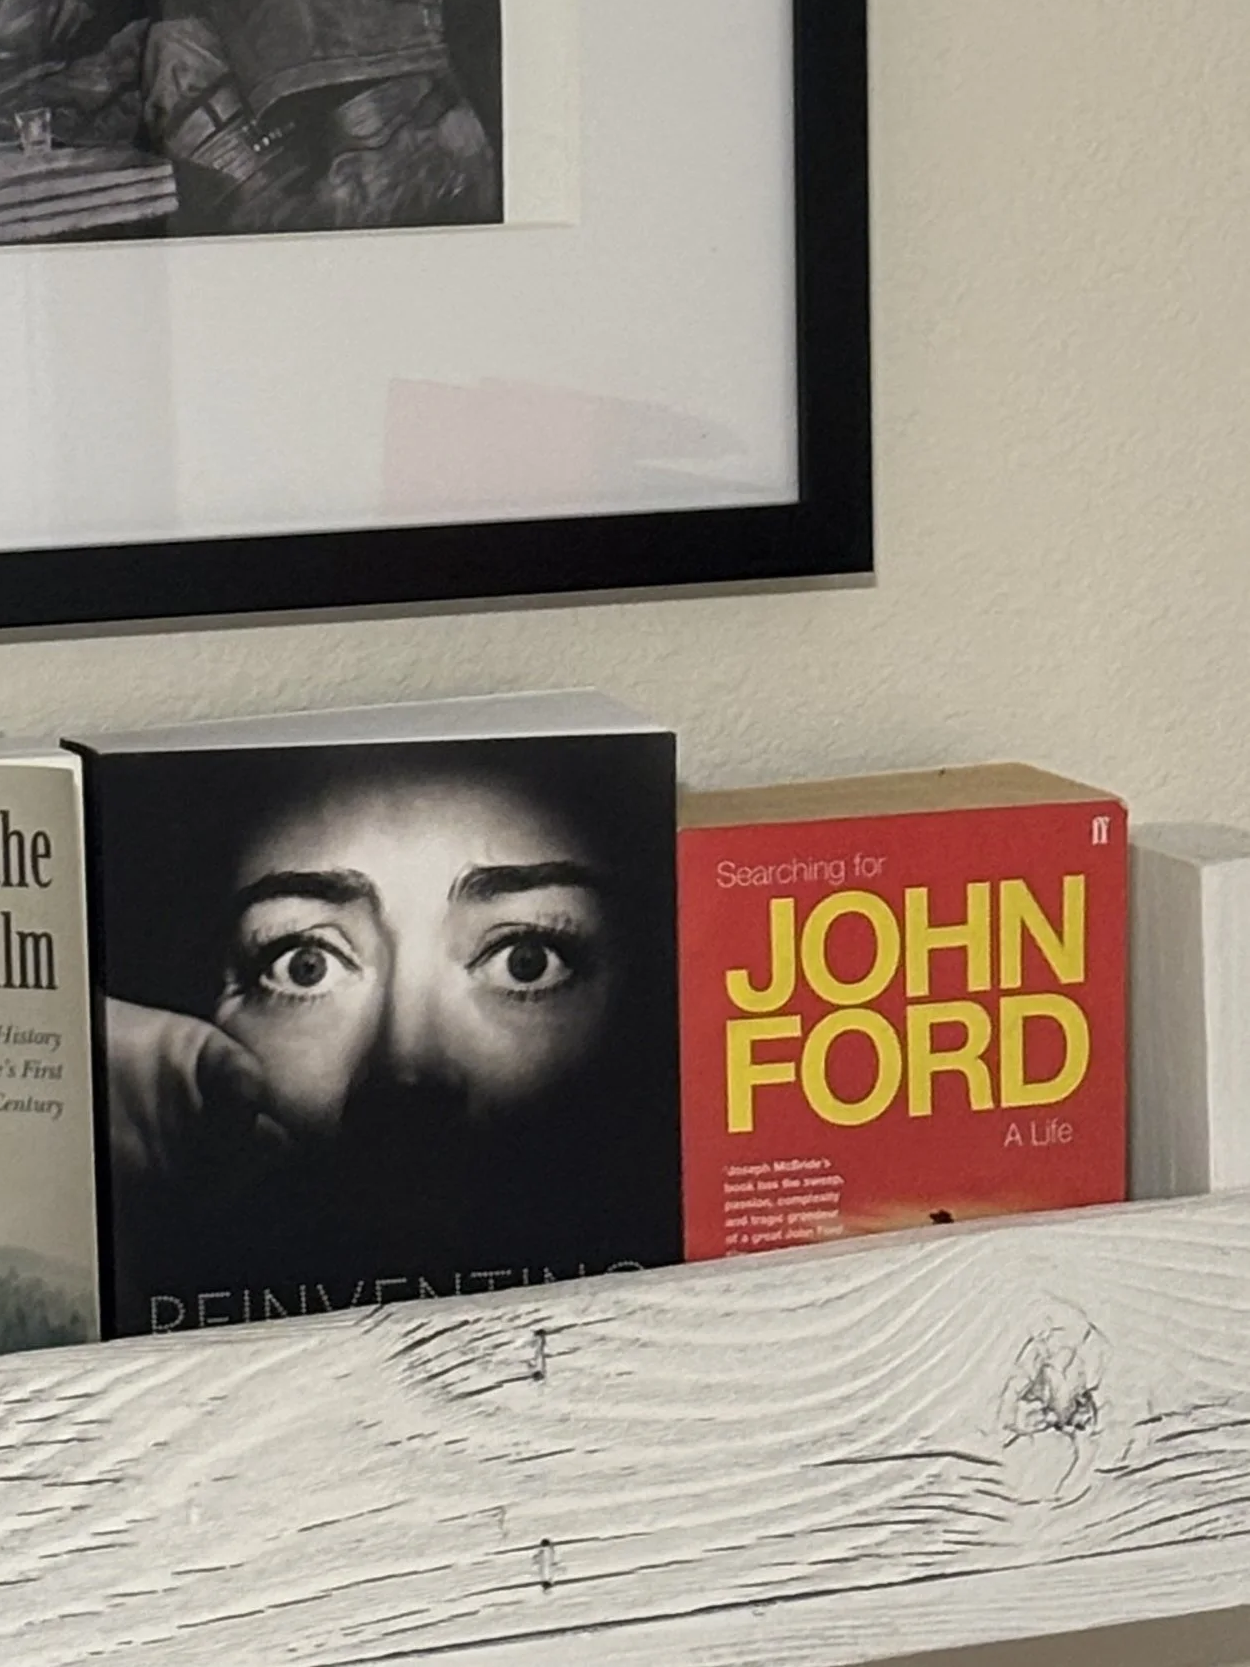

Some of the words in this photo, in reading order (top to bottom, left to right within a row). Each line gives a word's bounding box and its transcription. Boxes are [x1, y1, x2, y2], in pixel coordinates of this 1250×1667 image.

[716, 855, 846, 890] Searching
[853, 852, 887, 879] for
[725, 874, 1086, 1013] JOHN
[21, 1059, 63, 1080] First
[725, 992, 1091, 1133] FORD
[1004, 1122, 1024, 1148] A
[1030, 1118, 1073, 1146] Life
